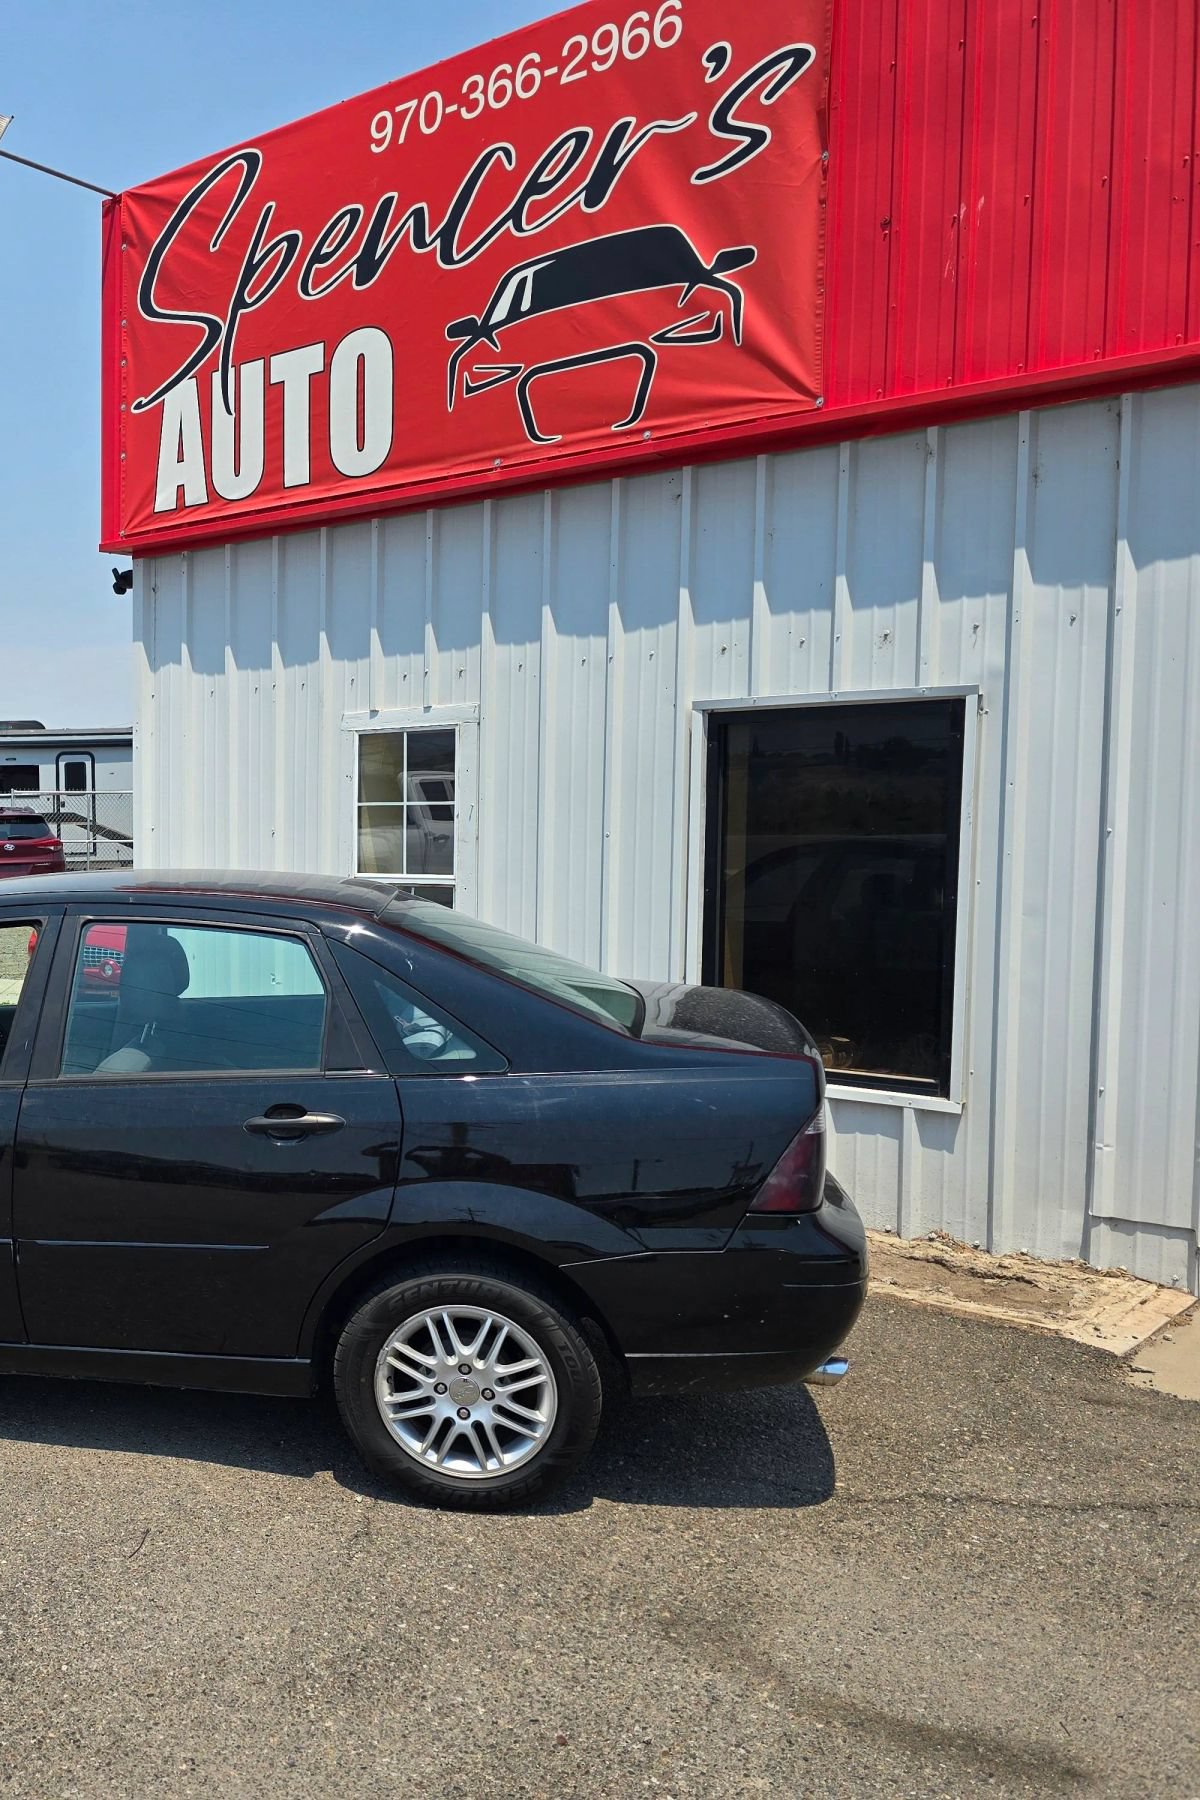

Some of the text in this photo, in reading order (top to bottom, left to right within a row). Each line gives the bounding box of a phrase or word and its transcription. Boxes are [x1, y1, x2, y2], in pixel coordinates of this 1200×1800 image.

[370, 0, 683, 153] 970-366-2966
[131, 41, 816, 415] Spencer's
[153, 326, 395, 514] AUTO
